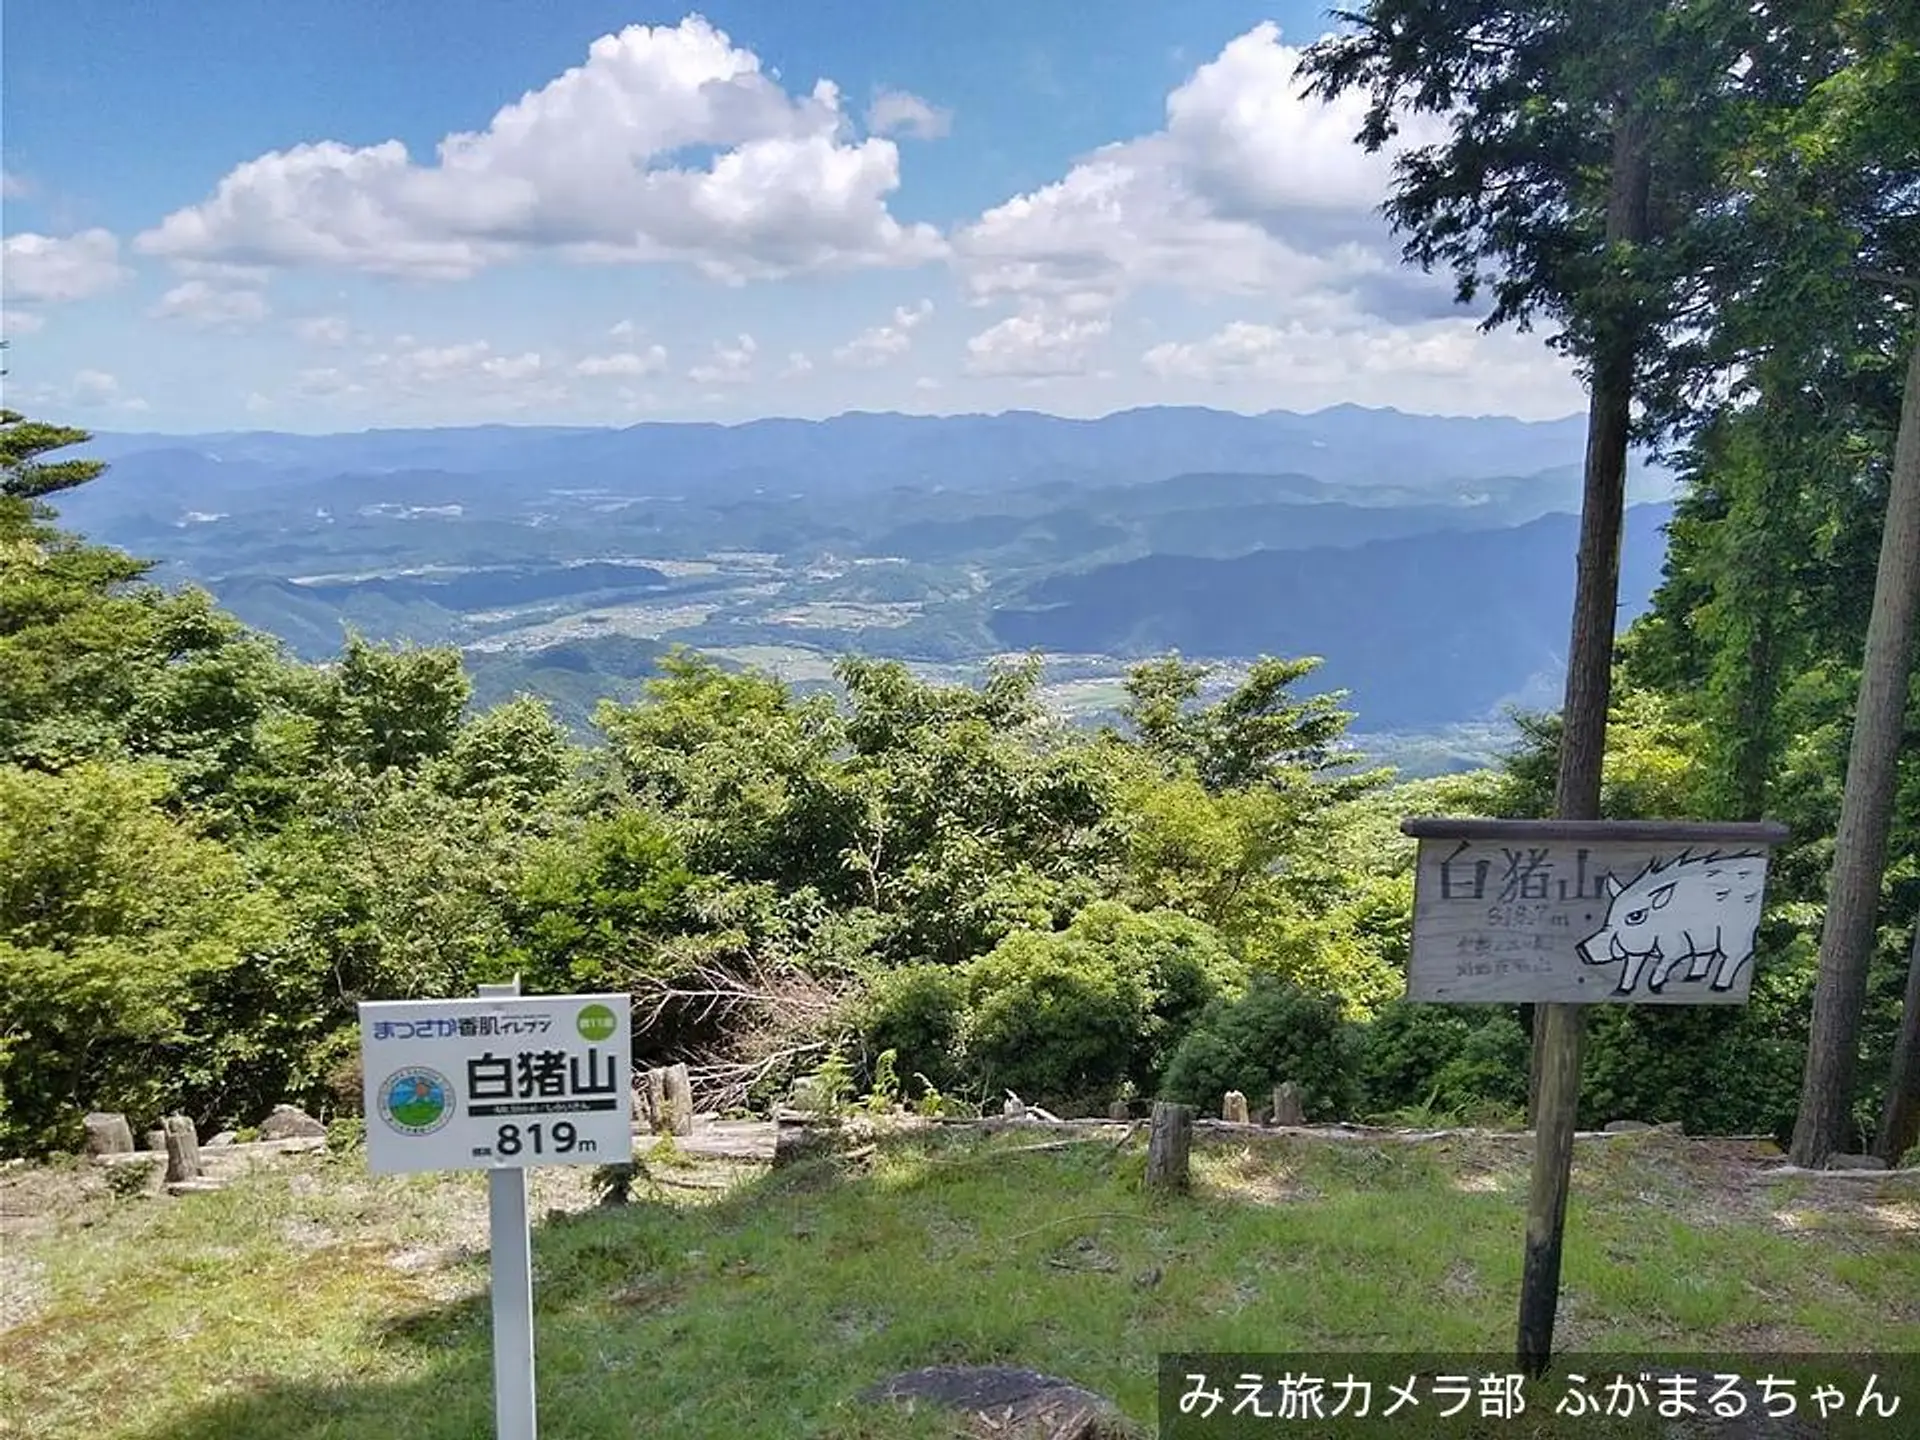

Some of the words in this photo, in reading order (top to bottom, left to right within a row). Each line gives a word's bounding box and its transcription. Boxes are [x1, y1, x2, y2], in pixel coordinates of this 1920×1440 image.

[1439, 840, 1605, 904] 白猪山
[467, 1048, 617, 1099] 白猪山
